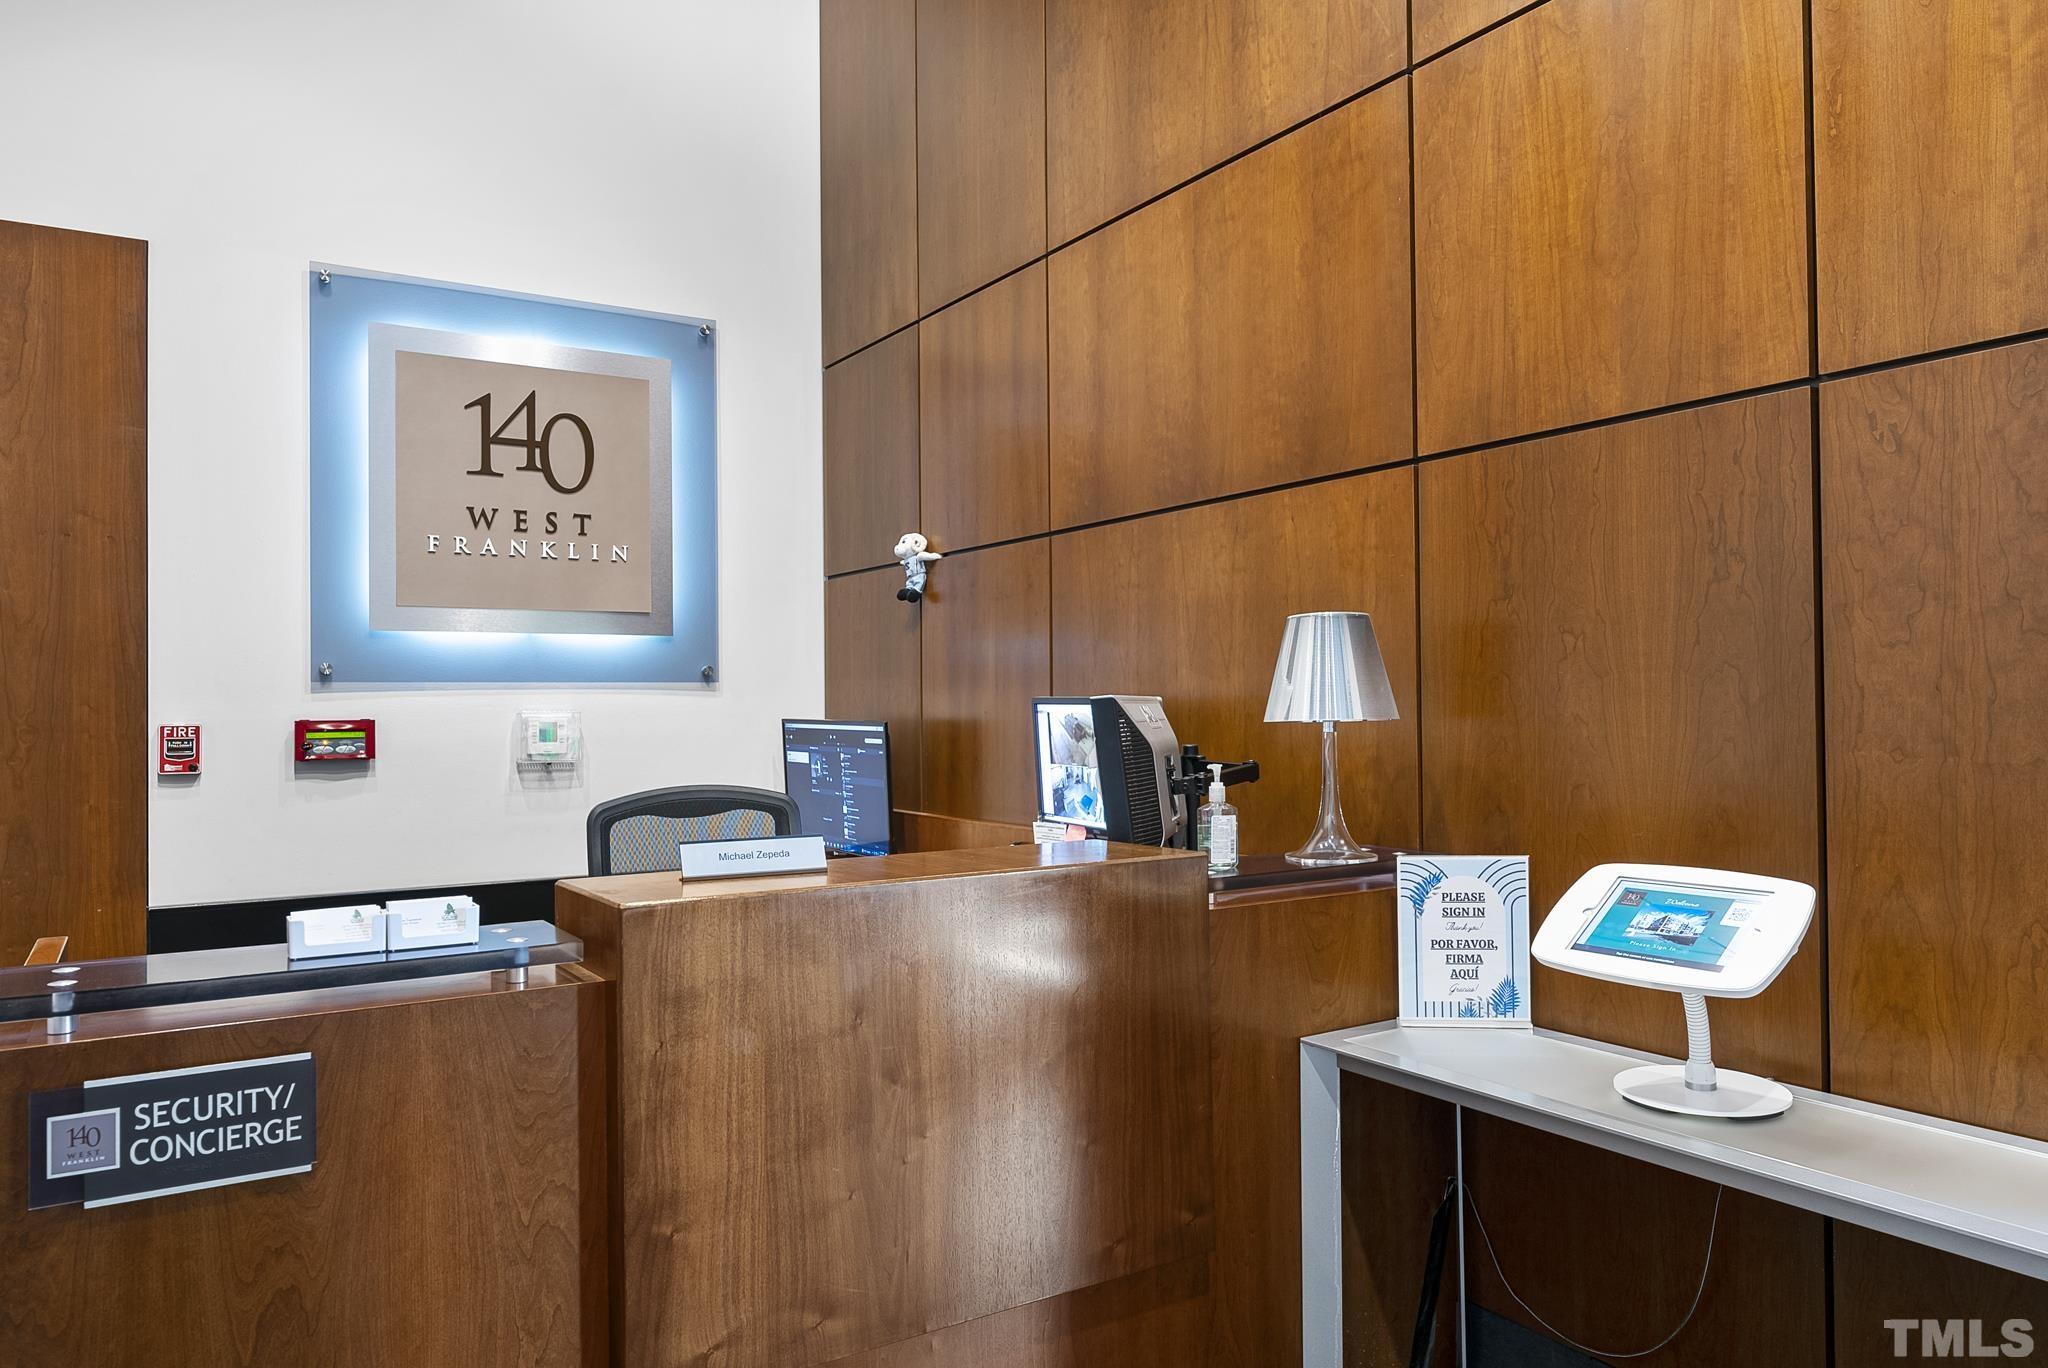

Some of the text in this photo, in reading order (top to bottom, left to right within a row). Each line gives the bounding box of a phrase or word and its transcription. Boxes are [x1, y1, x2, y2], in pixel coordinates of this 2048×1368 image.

[464, 390, 595, 494] 140
[466, 506, 592, 536] WEST
[427, 534, 629, 563] FRANKLIN
[164, 726, 196, 738] FIRE
[718, 849, 790, 862] Michael Zepeda
[1441, 892, 1486, 903] PLEASE
[1441, 907, 1486, 918] SIGN IN
[1445, 921, 1468, 932] Thank
[1430, 939, 1498, 951] POR FAVOR,
[1629, 940, 1651, 949] Please
[1652, 943, 1668, 951] Sign
[1445, 954, 1484, 965] FIRMA
[1449, 966, 1480, 980] AQUÍ
[134, 1082, 296, 1131] SECURITY/
[66, 1125, 101, 1149] 140
[129, 1115, 303, 1166] CONCIERGE
[66, 1149, 101, 1160] WEST
